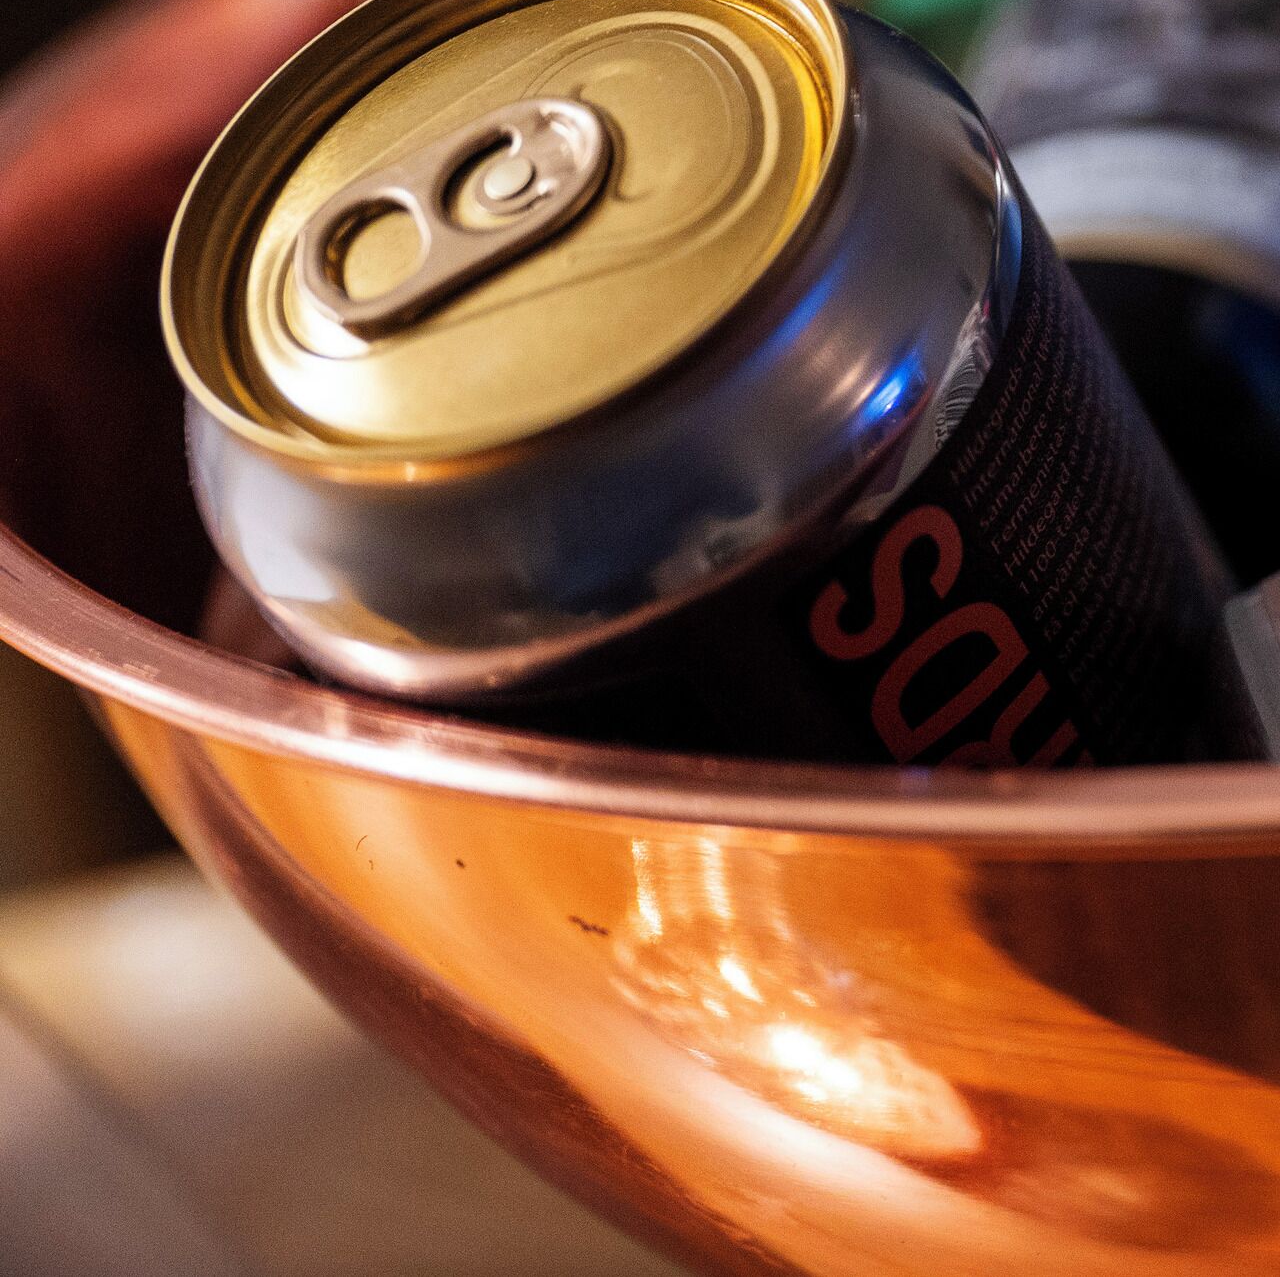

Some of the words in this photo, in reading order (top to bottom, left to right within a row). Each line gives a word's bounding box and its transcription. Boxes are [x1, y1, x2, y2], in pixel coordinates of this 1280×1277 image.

[961, 359, 1044, 512] International
[977, 410, 1049, 534] samarbete
[1001, 459, 1071, 579] Hildegard
[1017, 483, 1085, 596] 1100-talet
[809, 504, 1094, 769] RDS
